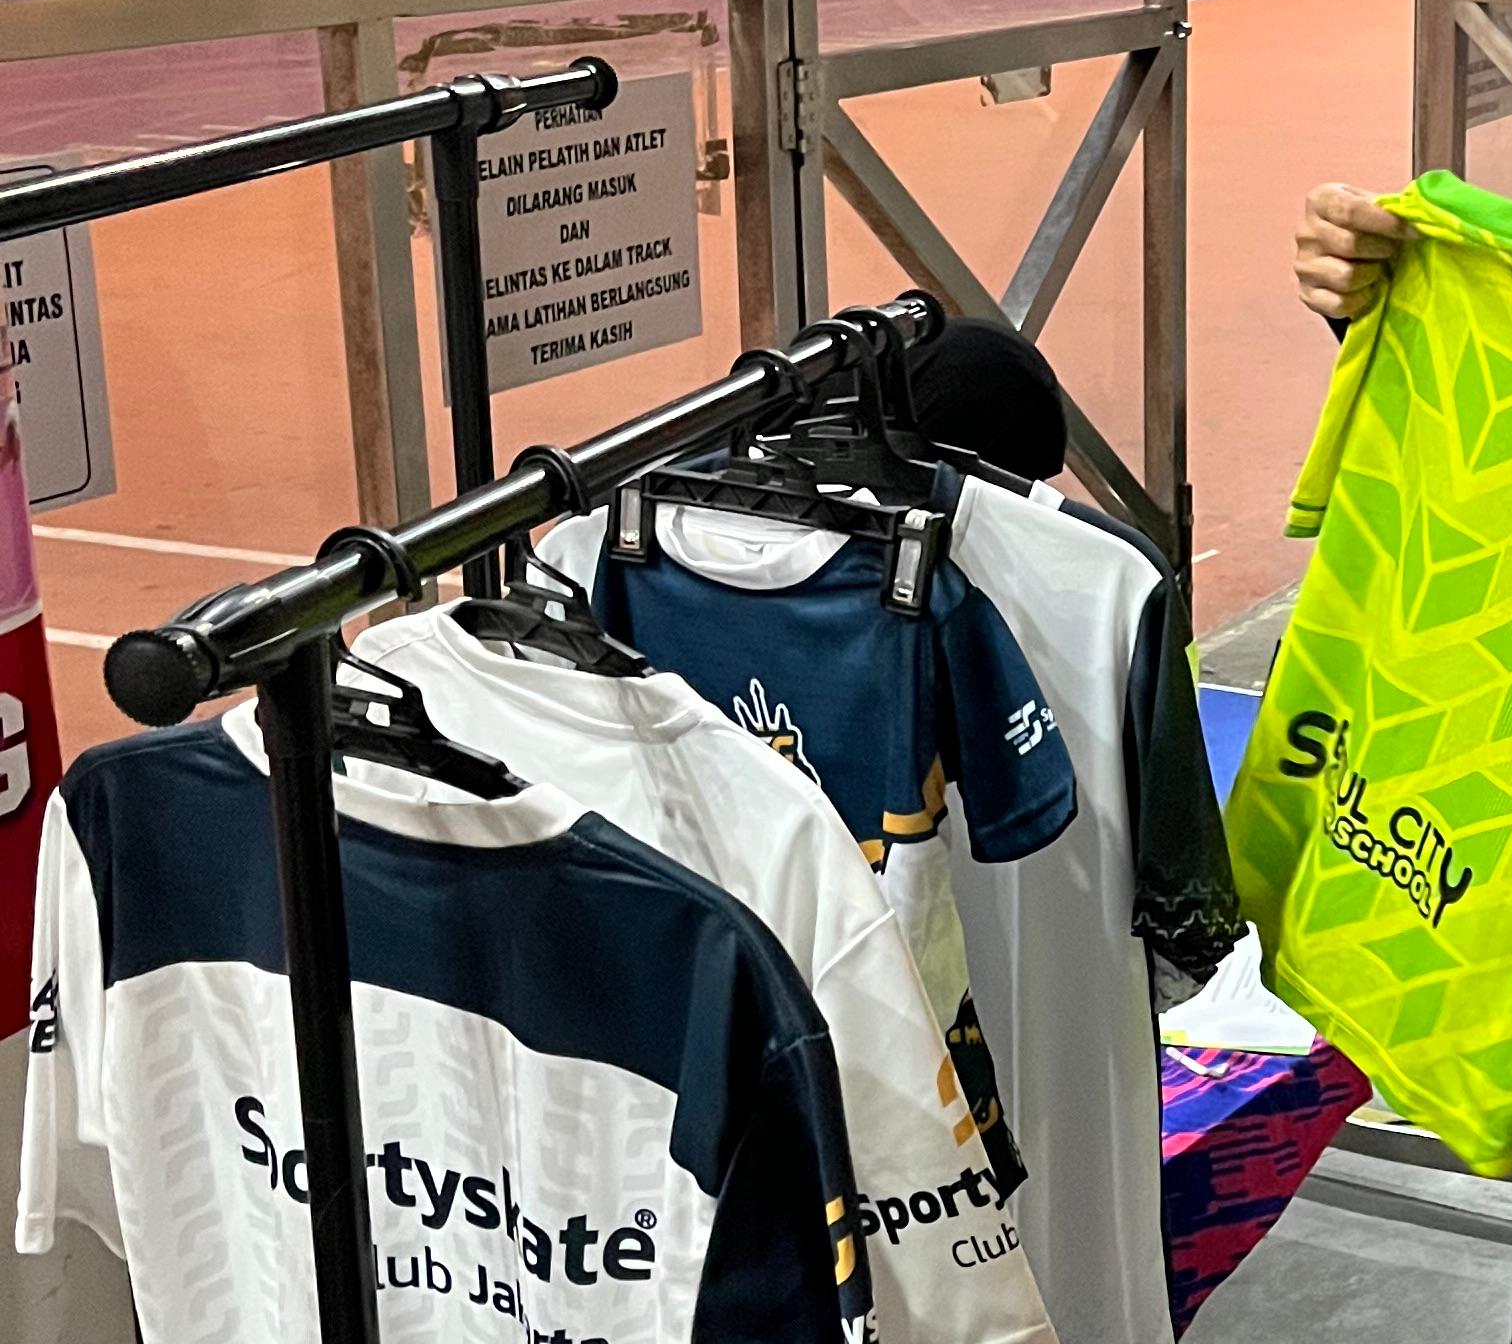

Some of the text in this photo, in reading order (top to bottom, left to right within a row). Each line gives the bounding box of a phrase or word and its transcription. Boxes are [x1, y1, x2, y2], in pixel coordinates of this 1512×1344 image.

[477, 128, 667, 181] ELAIN PELATIH DAN ATLET
[506, 172, 638, 217] DILARANG MASUK
[560, 219, 590, 244] DAN
[485, 236, 673, 299] ELINTAS KE DALAM TRACK
[486, 269, 691, 339] AMA LATIHAN BERLANGSUNG
[530, 320, 633, 366] TERIMA KASIH
[1389, 806, 1473, 930] CITY
[372, 1243, 453, 1294] lub
[951, 1222, 1020, 1268] Club
